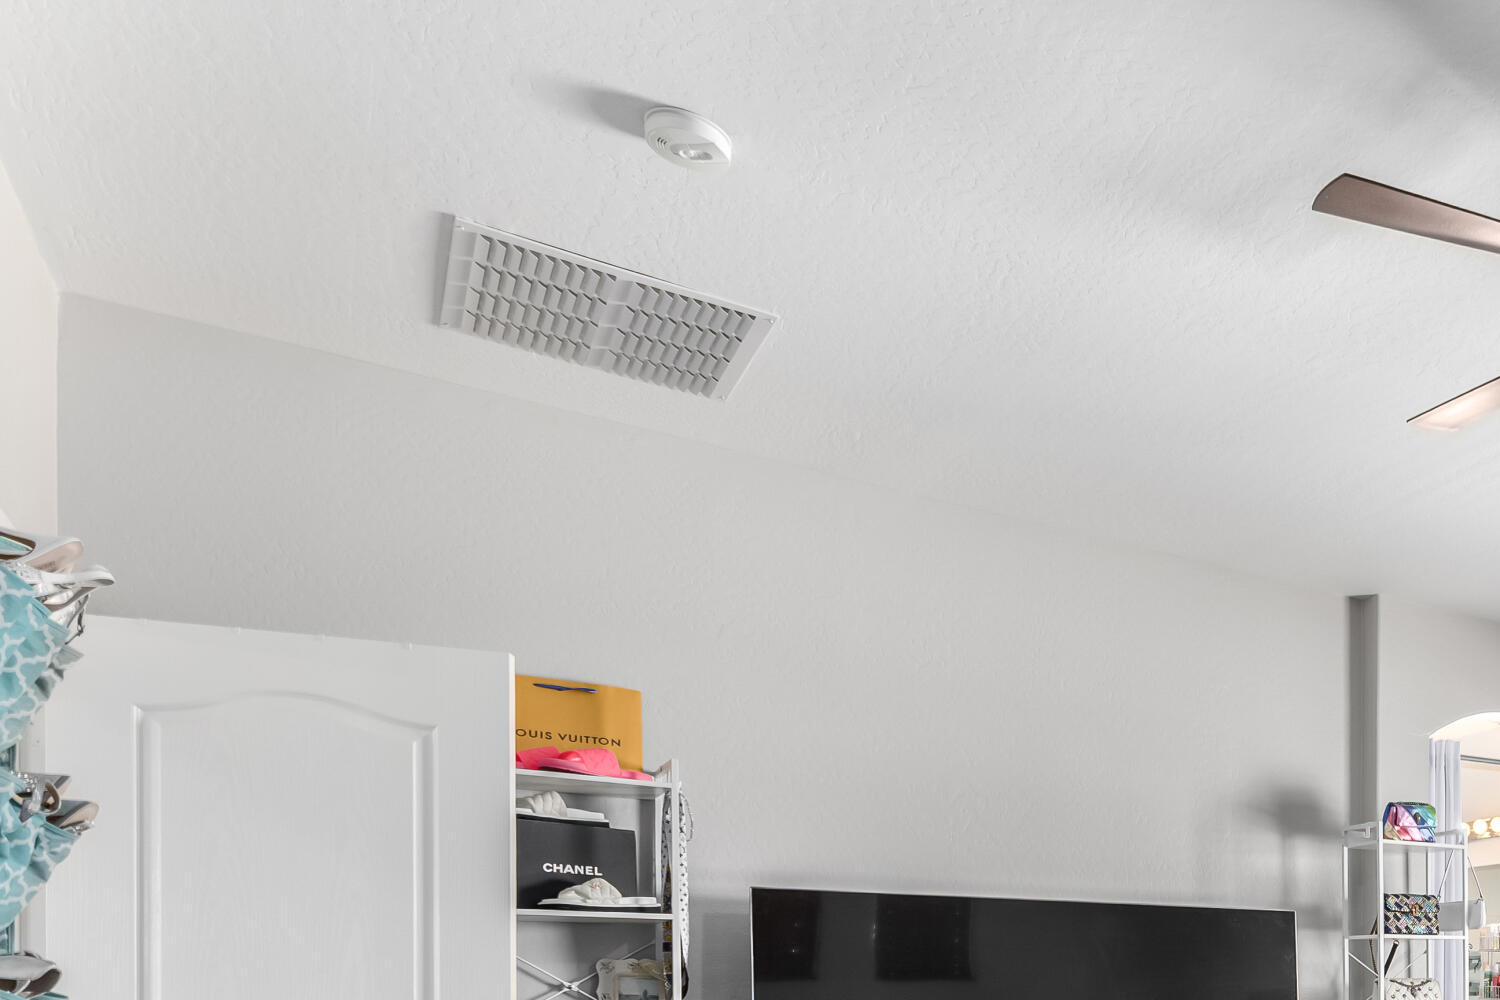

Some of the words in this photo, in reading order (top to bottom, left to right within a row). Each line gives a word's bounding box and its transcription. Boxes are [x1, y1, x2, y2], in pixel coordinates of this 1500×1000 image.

[515, 728, 552, 740] OUIS
[558, 733, 622, 748] VUITTON
[542, 862, 603, 877] CHANEL
